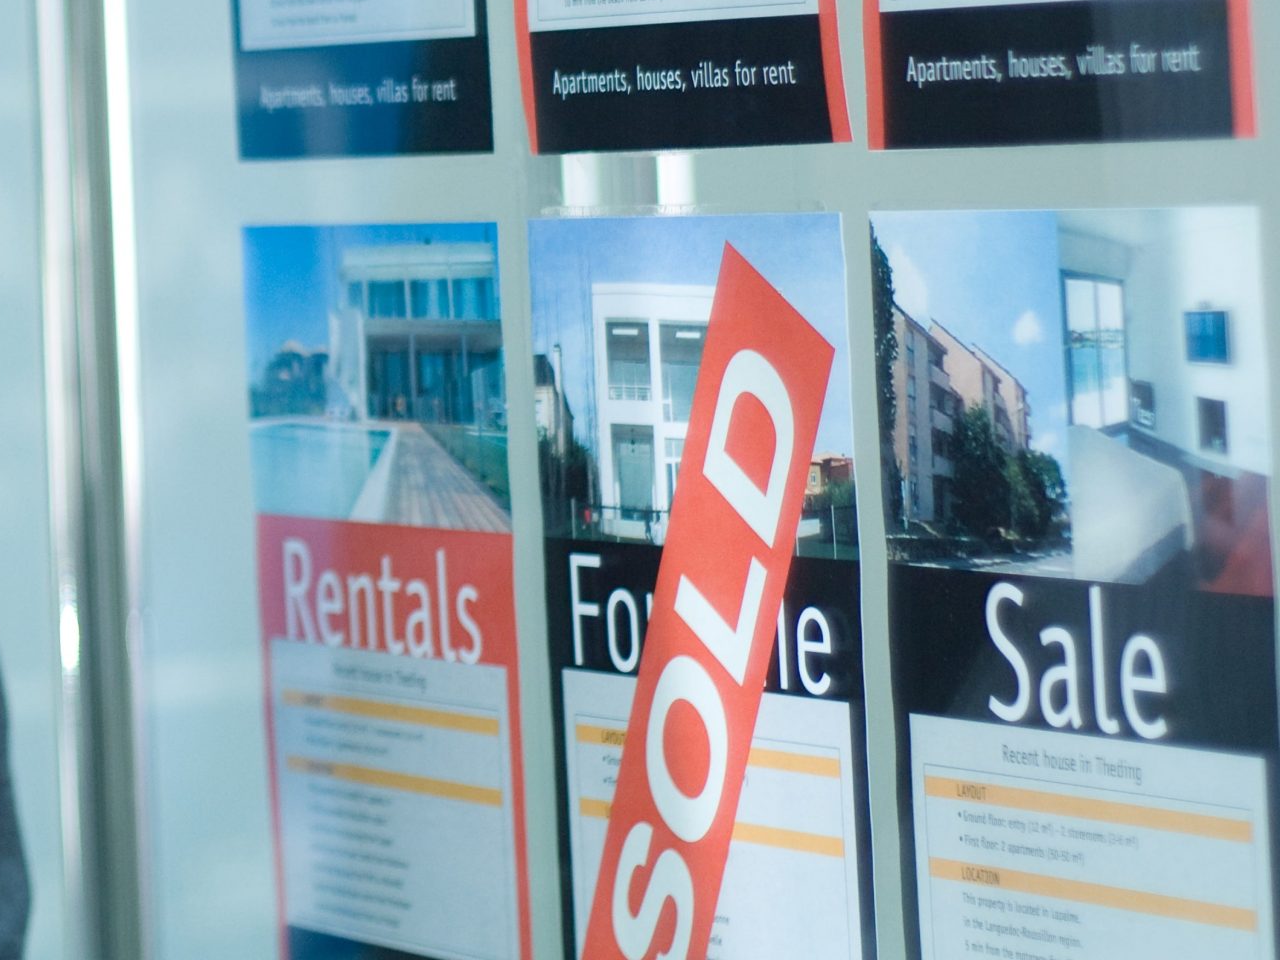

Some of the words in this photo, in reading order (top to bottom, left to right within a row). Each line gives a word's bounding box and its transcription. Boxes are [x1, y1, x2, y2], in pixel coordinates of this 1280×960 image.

[552, 68, 632, 100] Apartments,
[636, 64, 686, 94] houses,
[691, 61, 729, 89] villas
[734, 59, 756, 86] for
[763, 62, 796, 85] rent
[906, 55, 1002, 89] Apartments,
[1008, 49, 1072, 80] houses,
[1077, 46, 1126, 75] villas
[1130, 42, 1155, 74] for
[1161, 46, 1201, 73] rent
[260, 83, 327, 113] Apartments,
[329, 80, 373, 106] houses,
[377, 78, 409, 103] villas
[412, 75, 428, 101] for
[431, 79, 457, 102] rent
[281, 537, 484, 665] Rentals
[569, 552, 654, 673] Fo
[612, 349, 795, 960] SOLD
[985, 580, 1169, 739] Sale
[1002, 743, 1040, 769] Recent
[1043, 753, 1077, 773] house
[1079, 755, 1092, 775] in
[1096, 756, 1143, 786] Theding
[956, 782, 987, 801] LAYOUT
[961, 866, 1000, 885] LOCATION
